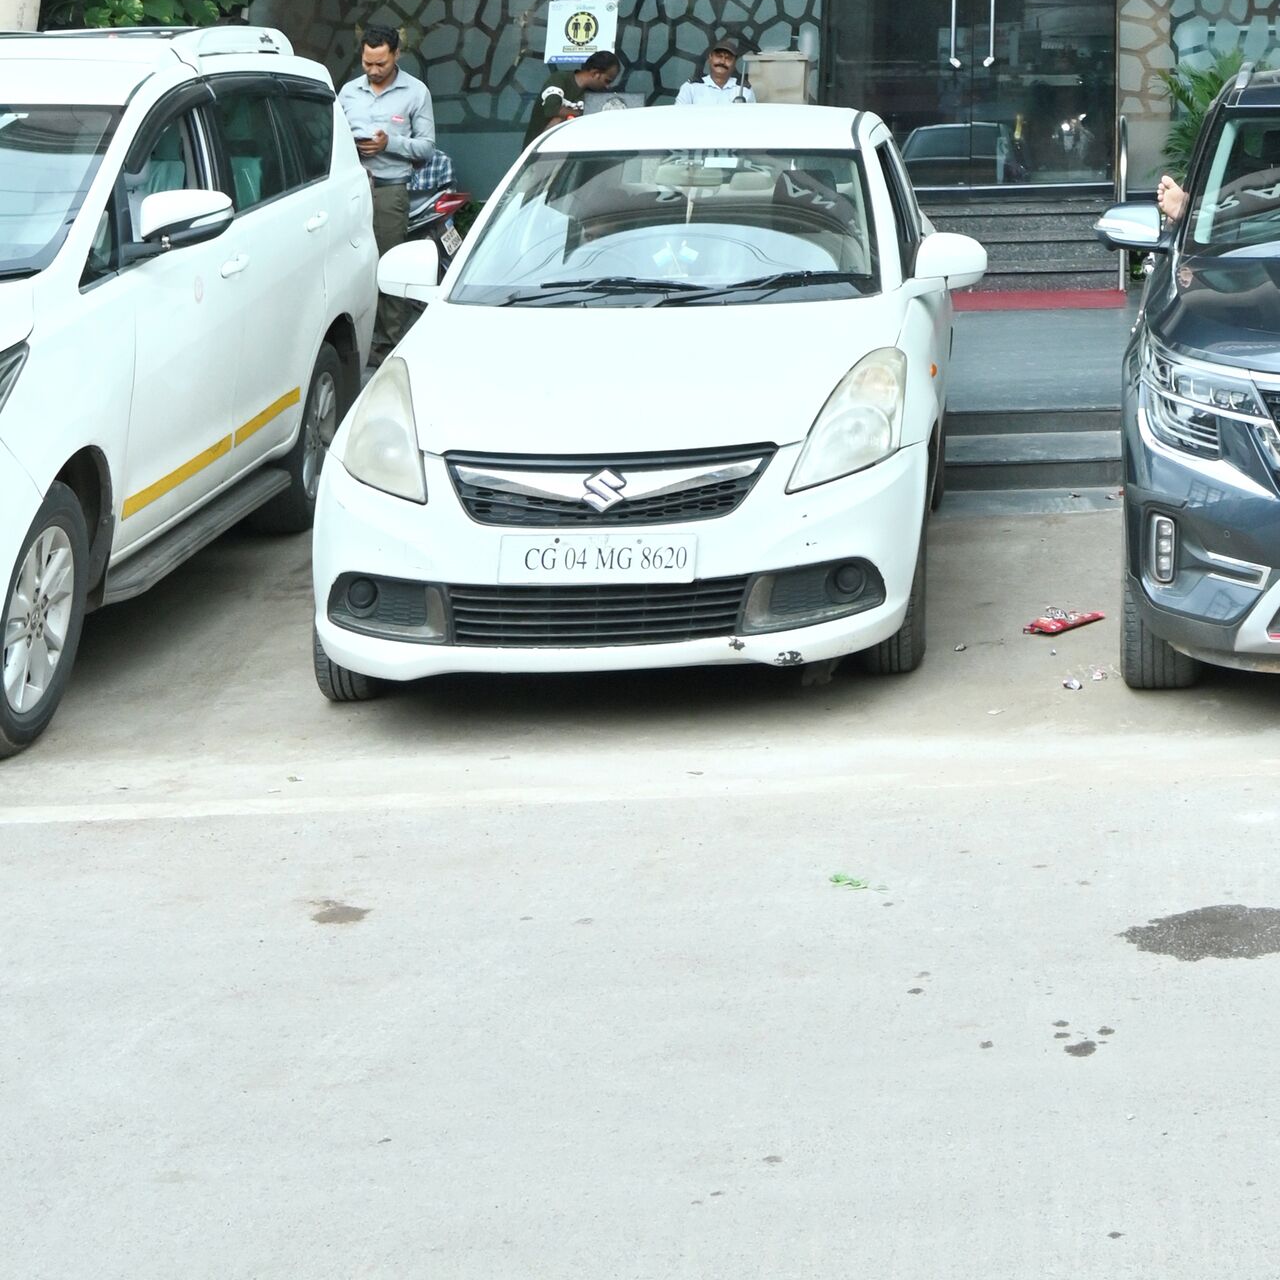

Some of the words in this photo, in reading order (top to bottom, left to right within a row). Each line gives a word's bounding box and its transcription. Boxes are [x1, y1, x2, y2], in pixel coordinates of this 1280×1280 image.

[524, 547, 557, 571] CG
[564, 547, 588, 570] 04
[595, 546, 633, 570] MG
[640, 546, 688, 570] 8620
